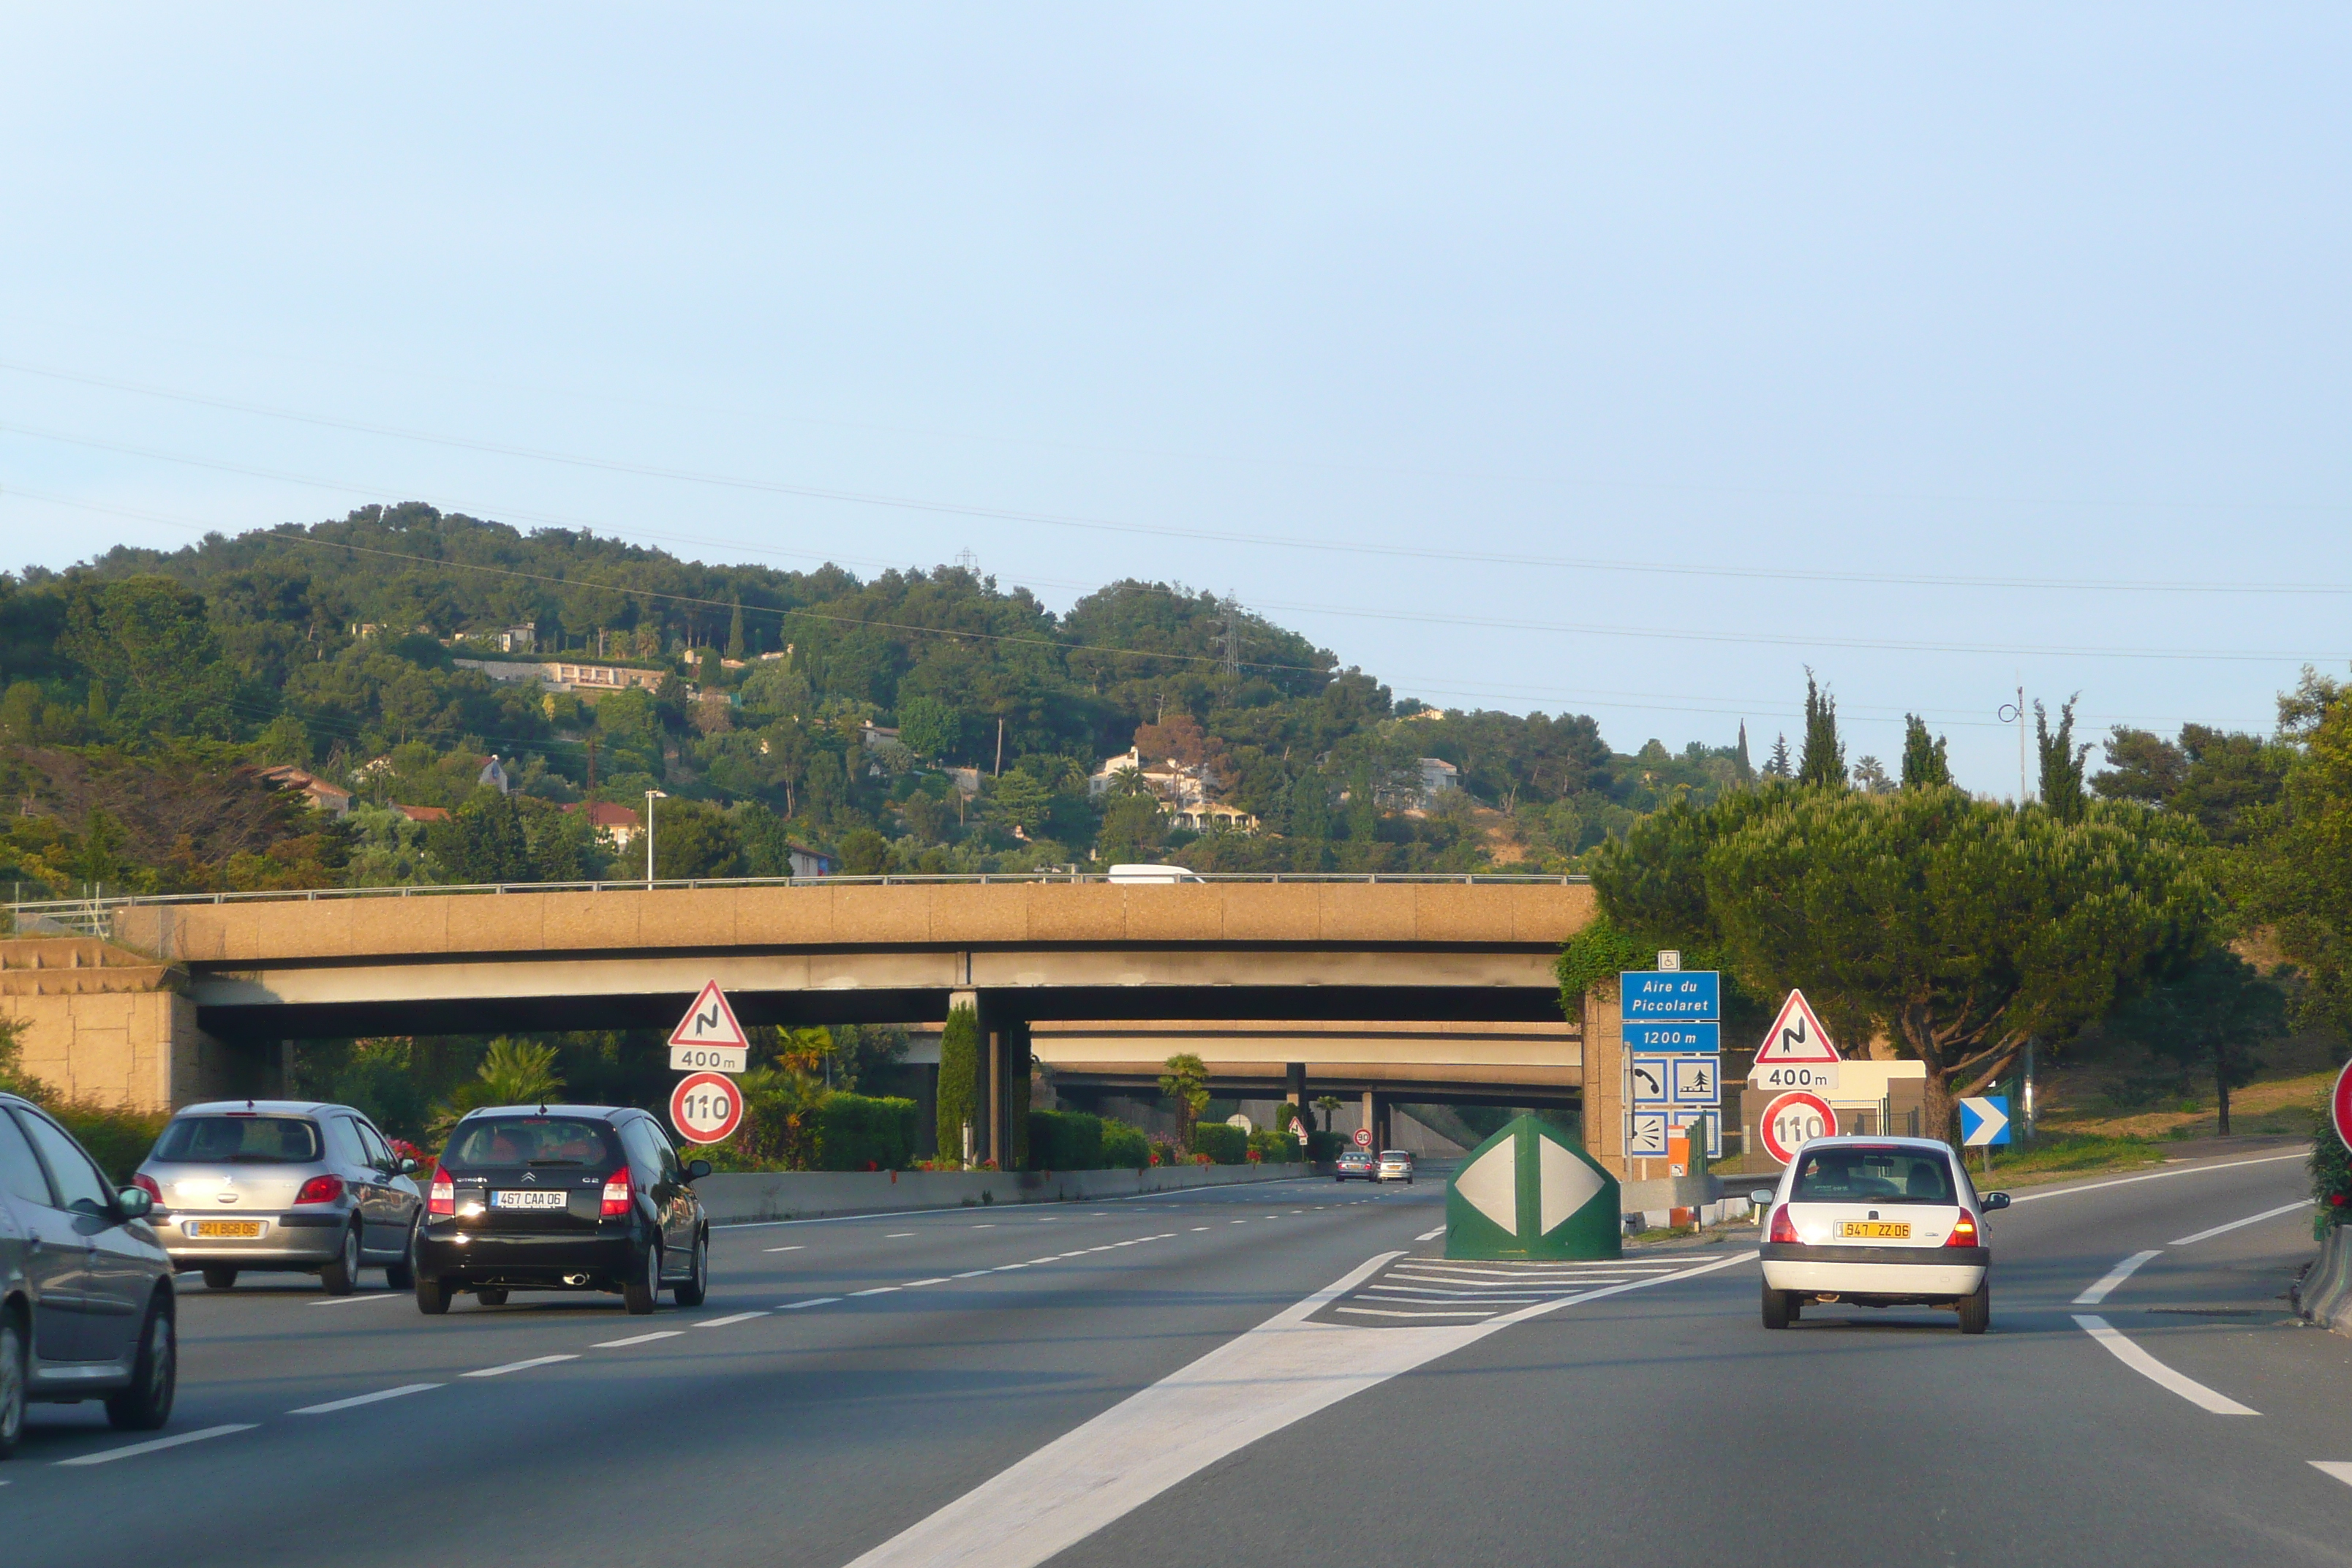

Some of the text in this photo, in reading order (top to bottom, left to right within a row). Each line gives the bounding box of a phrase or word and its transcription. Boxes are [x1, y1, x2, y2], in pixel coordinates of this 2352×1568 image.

[1643, 980, 1697, 992] Aire du
[1632, 999, 1709, 1011] Piccolaret
[1644, 1032, 1697, 1044] 1200 m
[681, 1051, 735, 1068] 400 m
[1768, 1068, 1828, 1086] 400 m
[684, 1095, 730, 1120] 110
[1774, 1115, 1825, 1142] 110
[1357, 1134, 1369, 1142] 90
[500, 1193, 561, 1205] 467 CAA 06
[1847, 1224, 1909, 1237] 947 ZZ 06
